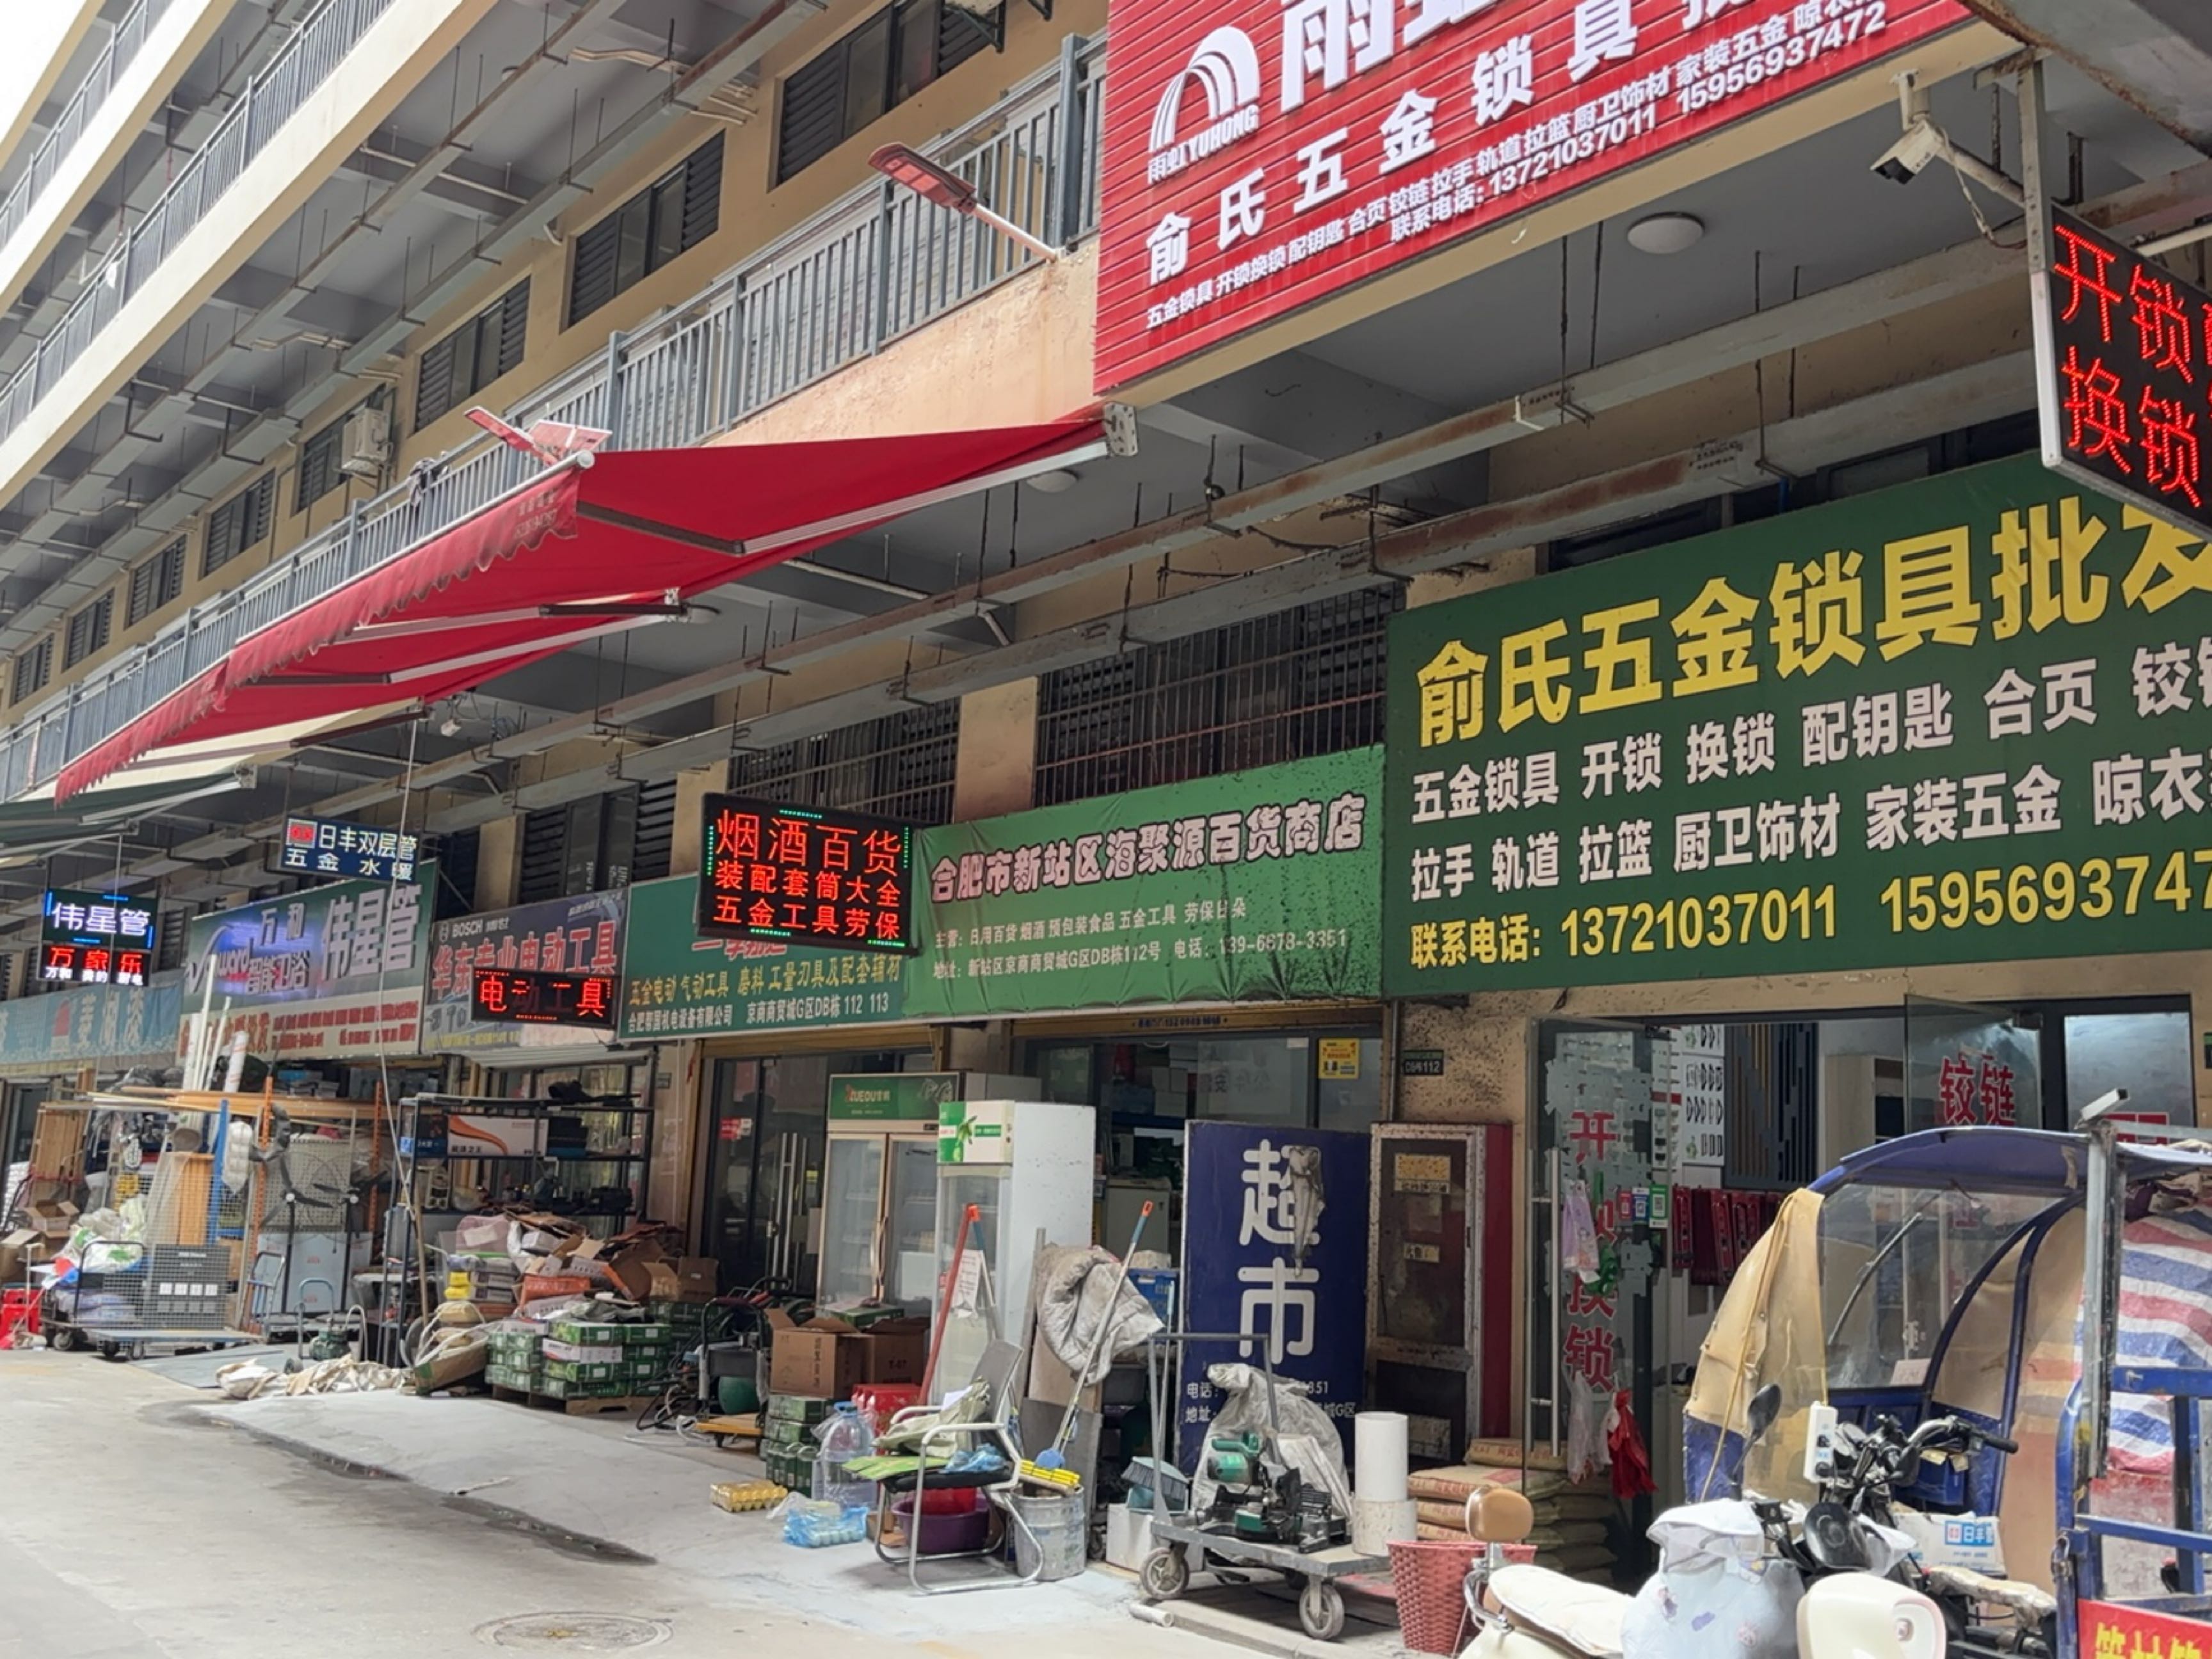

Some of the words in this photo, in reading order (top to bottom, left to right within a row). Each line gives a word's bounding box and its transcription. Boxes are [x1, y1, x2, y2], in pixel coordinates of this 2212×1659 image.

[1489, 106, 1658, 196] 13721037011
[1676, 2, 1887, 116] 15956937472
[1189, 104, 1259, 163] YUHONG
[1146, 278, 1214, 329] 五金锁具
[1288, 223, 1345, 266] 配钥匙
[1348, 201, 1386, 236] 合页
[1389, 179, 1430, 216] 铰链
[1431, 159, 1473, 198] 拉手
[1477, 132, 1521, 177] 轨道
[1525, 104, 1571, 156] 拉篮
[1572, 67, 1672, 134] 厨卫饰材
[1676, 12, 1790, 88] 家装五金
[2053, 224, 2212, 384] 开锁
[2060, 345, 2212, 508] 换锁
[1411, 751, 1560, 824] 五金锁具
[1580, 732, 1663, 800] 开锁
[1686, 712, 1776, 784] 换锁
[1801, 682, 1955, 767] 配钥匙
[1984, 658, 2097, 739] 合页
[2131, 636, 2212, 719] 铰
[318, 824, 419, 862] 日丰双层管
[715, 809, 902, 876] 烟酒百货
[931, 793, 1366, 902] 合肥市新站区海聚源百货商店
[1411, 843, 1474, 902] 拉手
[1491, 830, 1560, 894] 轨道
[1579, 819, 1653, 883] 拉篮
[1674, 792, 1841, 873] 厨卫饰材
[1866, 764, 2062, 851] 家装五金
[2092, 746, 2212, 826] 晾衣
[713, 895, 901, 940] 五金工具劳保
[714, 860, 901, 909] 装配套筒大全
[52, 902, 152, 936] 伟星管
[322, 884, 422, 982] 伟星管
[452, 919, 483, 938] BOSCH
[970, 922, 1018, 945] 日用百货
[1048, 911, 1115, 938] 预包装食品
[1119, 904, 1176, 929] 五金工具
[1561, 884, 1836, 957] 13721037011
[49, 947, 143, 974] 万家乐
[680, 971, 730, 1003] 气动工具
[844, 993, 863, 1015] 112
[869, 991, 890, 1014] 113
[1237, 1138, 1322, 1365] 超市
